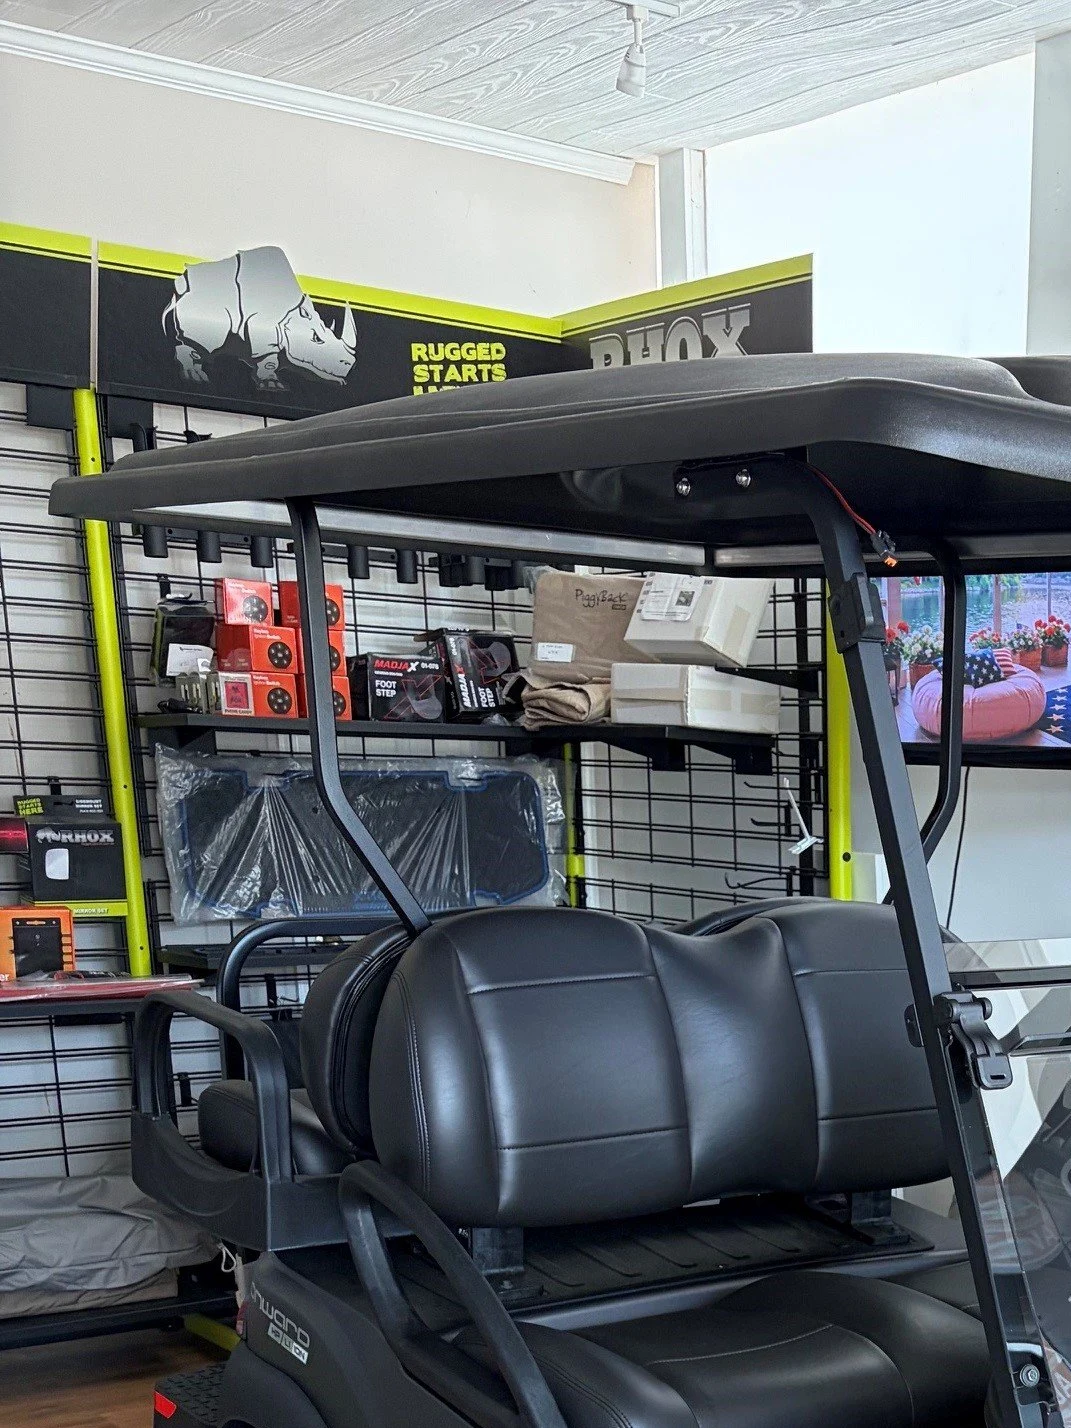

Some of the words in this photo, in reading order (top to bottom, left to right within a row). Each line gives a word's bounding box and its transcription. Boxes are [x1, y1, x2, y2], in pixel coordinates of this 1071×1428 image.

[411, 342, 507, 361] RUGGED
[412, 364, 507, 383] STARTS
[374, 659, 419, 672] MADJAX
[375, 680, 397, 689] FOOT
[375, 689, 397, 698] STEP
[19, 807, 44, 815] HERE
[60, 829, 115, 843] RHOX
